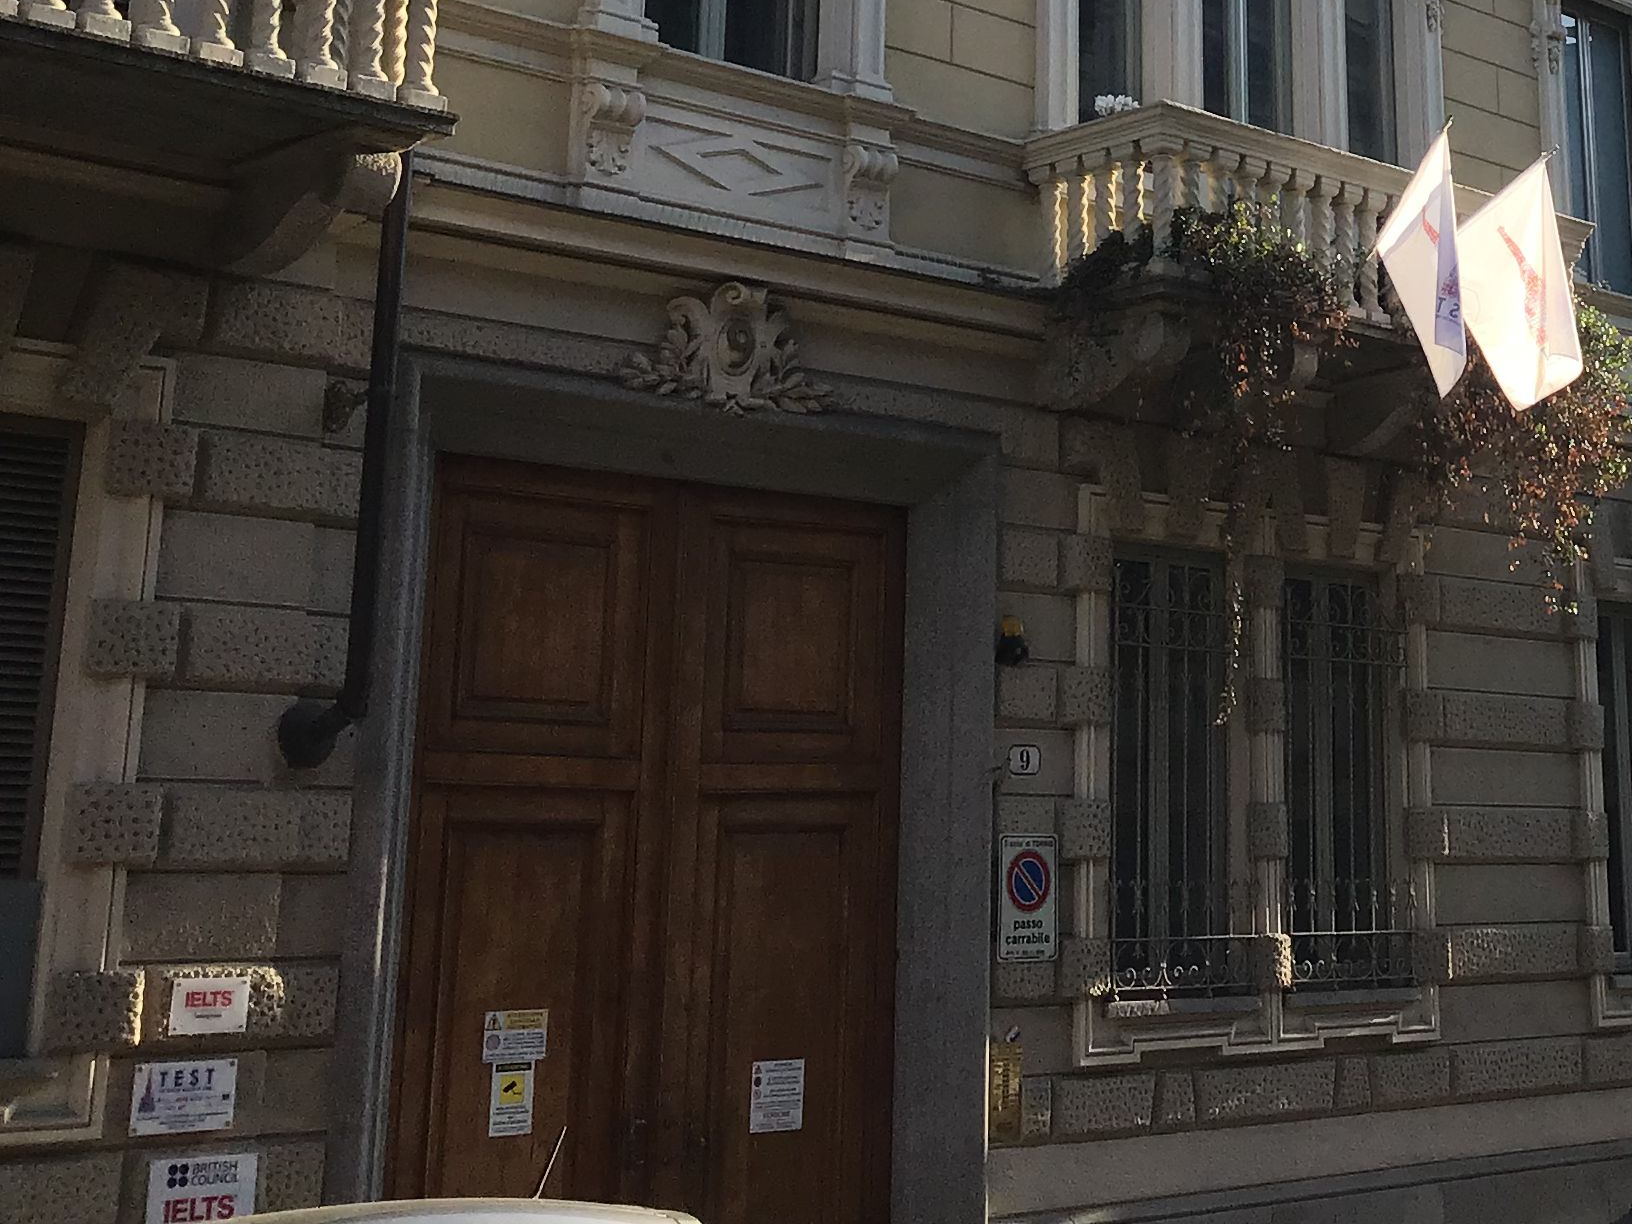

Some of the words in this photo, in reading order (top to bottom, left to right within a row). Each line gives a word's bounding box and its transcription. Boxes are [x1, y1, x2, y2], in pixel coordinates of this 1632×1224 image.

[1019, 748, 1031, 771] 9
[1014, 919, 1043, 931] passo
[1005, 932, 1050, 945] carrabile
[184, 990, 233, 1008] IELTS
[160, 1068, 215, 1088] TEST
[192, 1160, 238, 1175] BRITISH
[191, 1173, 238, 1186] COUNCIL
[163, 1195, 235, 1224] IELTS
